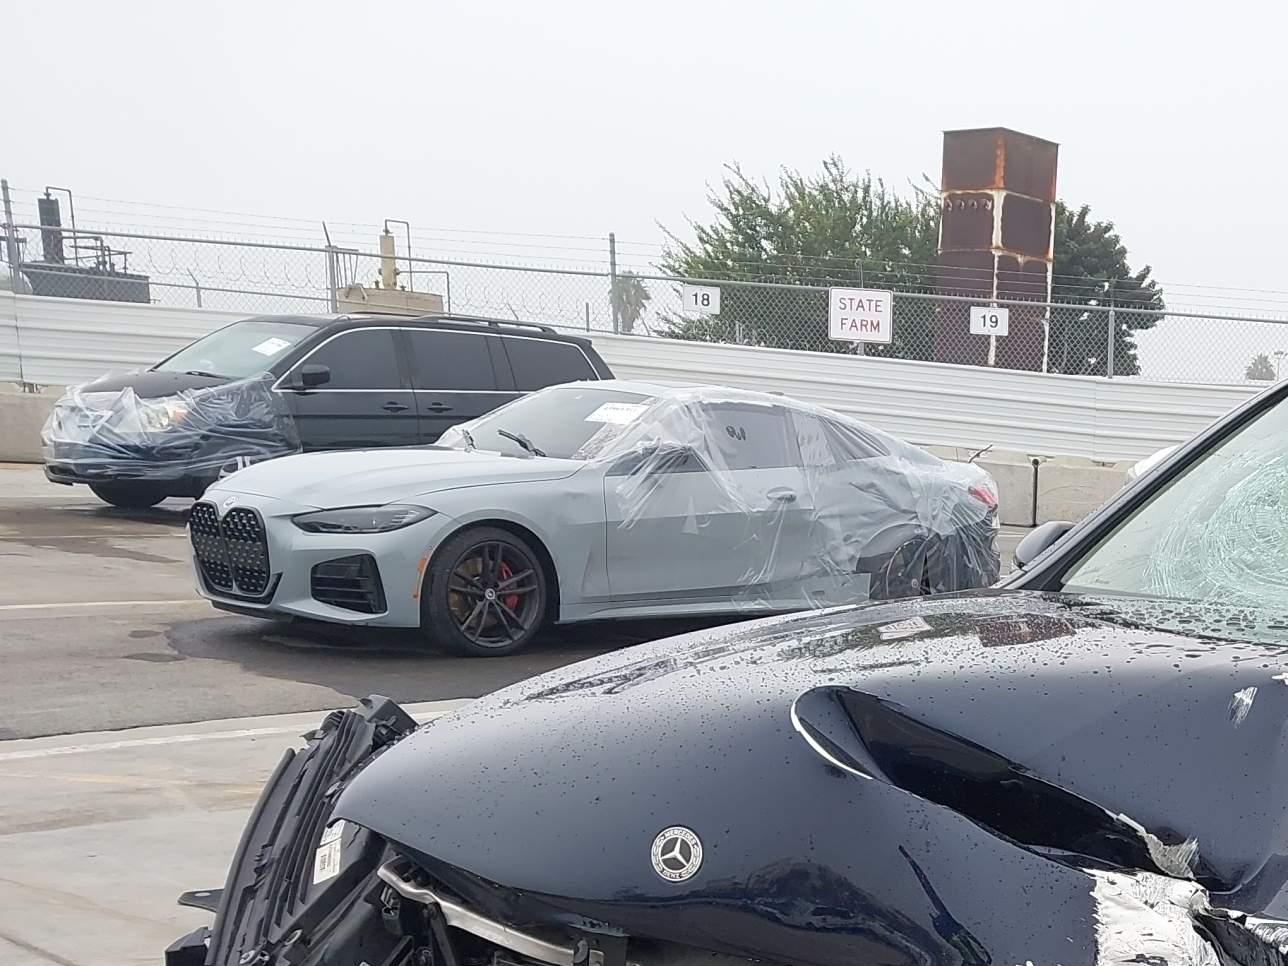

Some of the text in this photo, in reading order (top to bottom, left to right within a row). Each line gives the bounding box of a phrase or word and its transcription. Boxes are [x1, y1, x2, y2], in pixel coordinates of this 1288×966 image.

[691, 291, 710, 307] 18
[838, 297, 883, 313] STATE
[840, 317, 880, 333] FARM
[980, 314, 998, 329] 19
